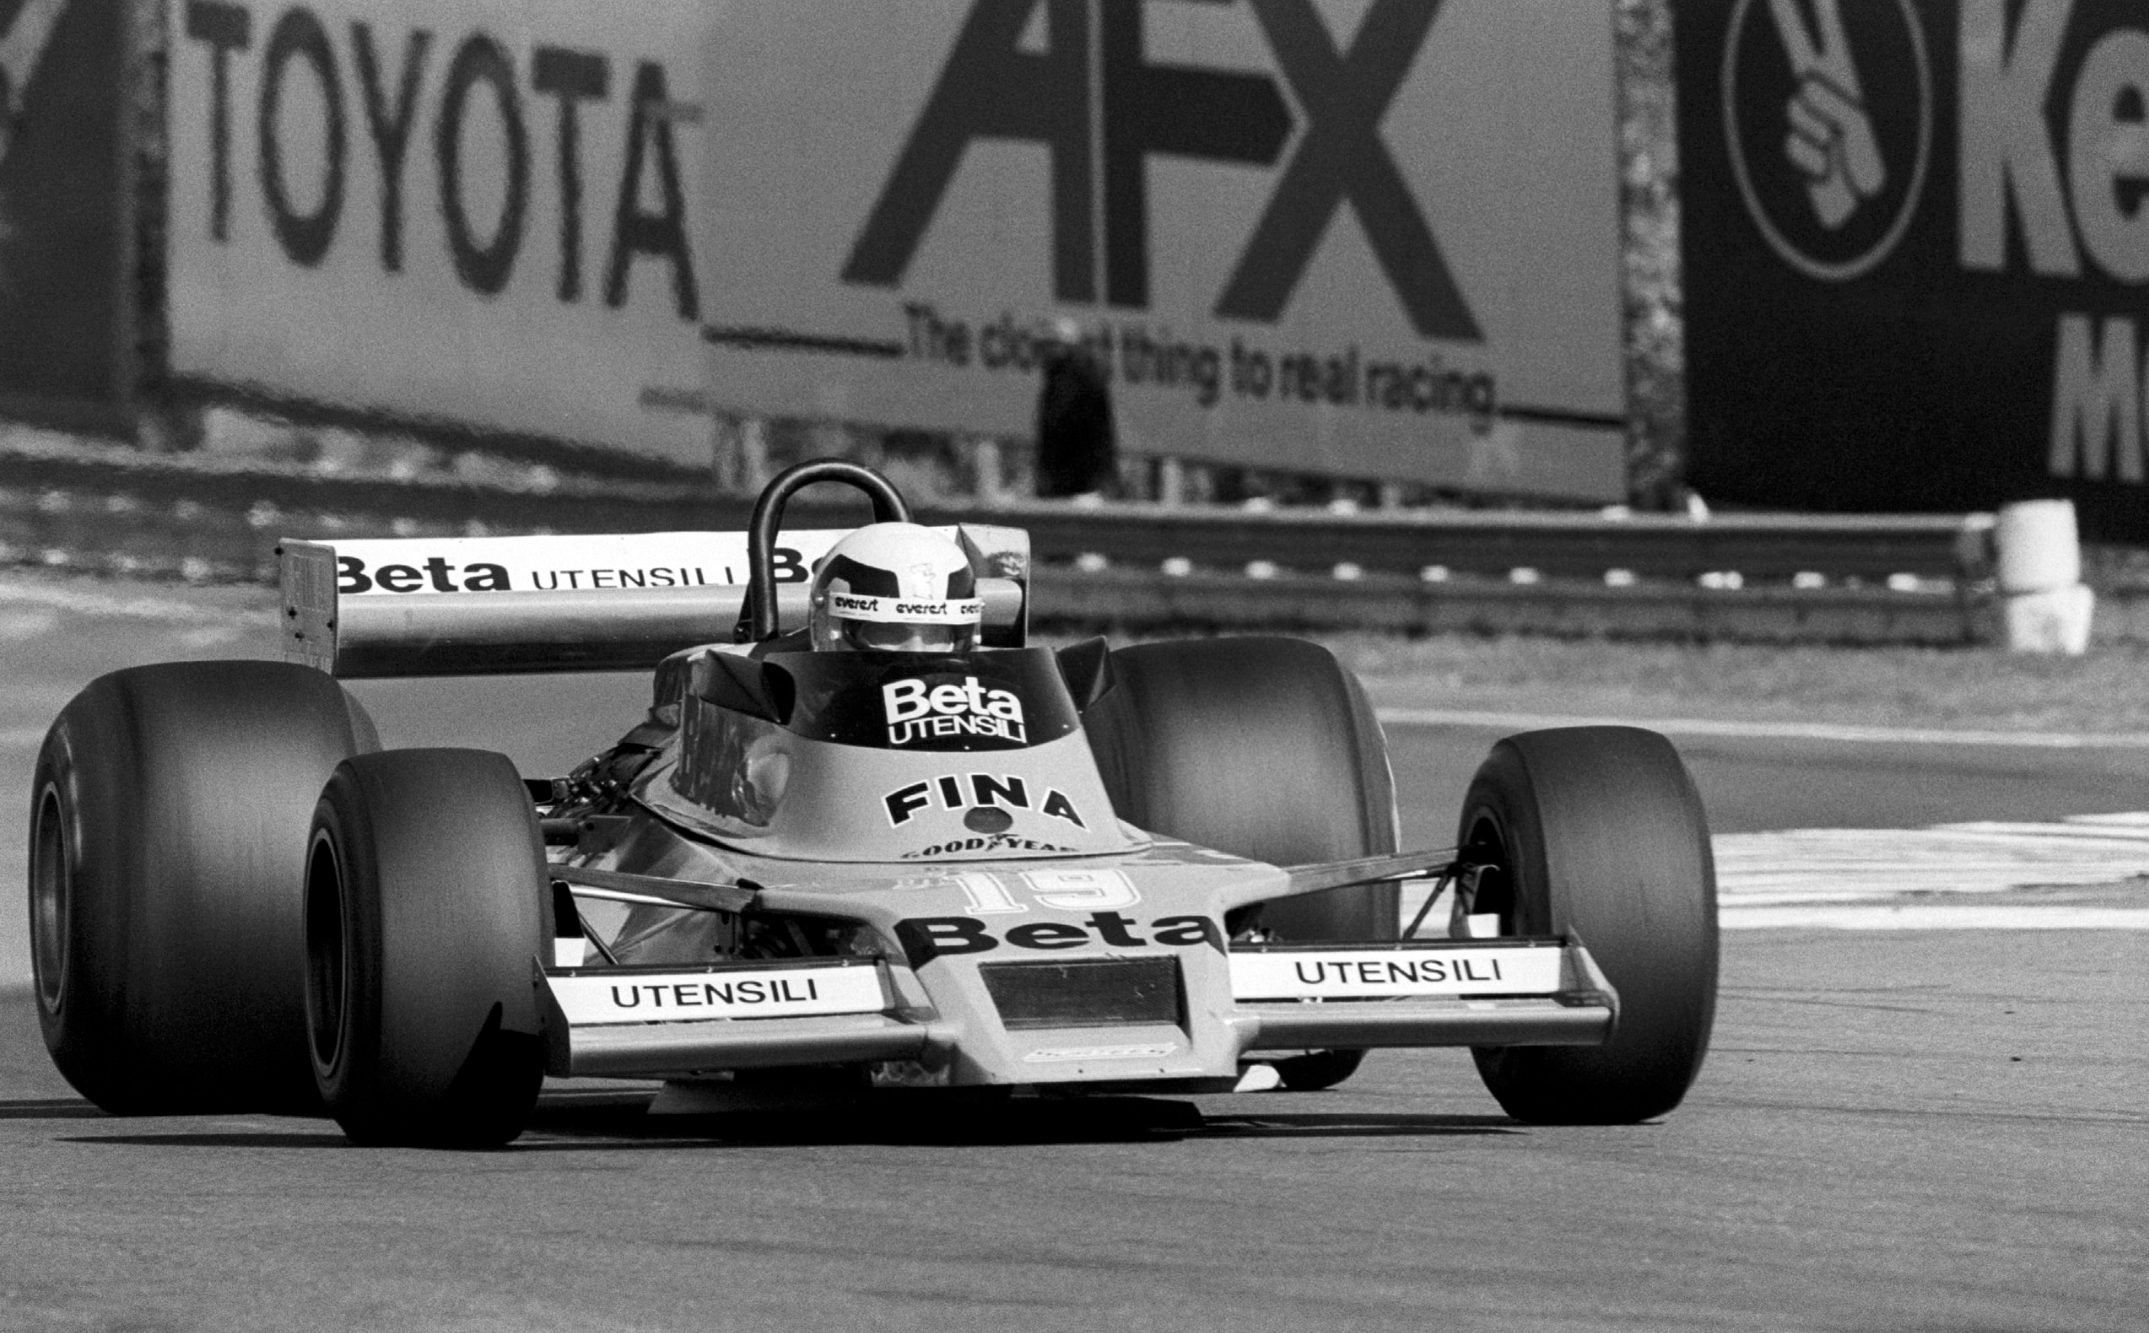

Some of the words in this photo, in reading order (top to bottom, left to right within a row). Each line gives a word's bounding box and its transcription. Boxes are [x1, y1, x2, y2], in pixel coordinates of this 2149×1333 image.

[185, 3, 700, 322] TOYOTA
[840, 0, 1486, 344] AFX
[903, 301, 971, 367] The
[1121, 322, 1221, 409] thing
[1230, 336, 1273, 398] to
[1281, 344, 1359, 406] real
[1366, 352, 1496, 436] racing
[2048, 311, 2149, 484] M
[337, 556, 512, 594] Beta
[531, 566, 735, 591] UTENSILI
[834, 596, 879, 612] everest
[896, 602, 948, 615] everest
[881, 676, 1023, 724] Beta
[887, 713, 1028, 745] UTENSILI
[881, 772, 1090, 832] FINA
[953, 868, 1142, 915] 19
[893, 910, 1228, 970] Beta
[610, 977, 819, 1009] UTENSILI
[1296, 957, 1504, 986] UTENSILI
